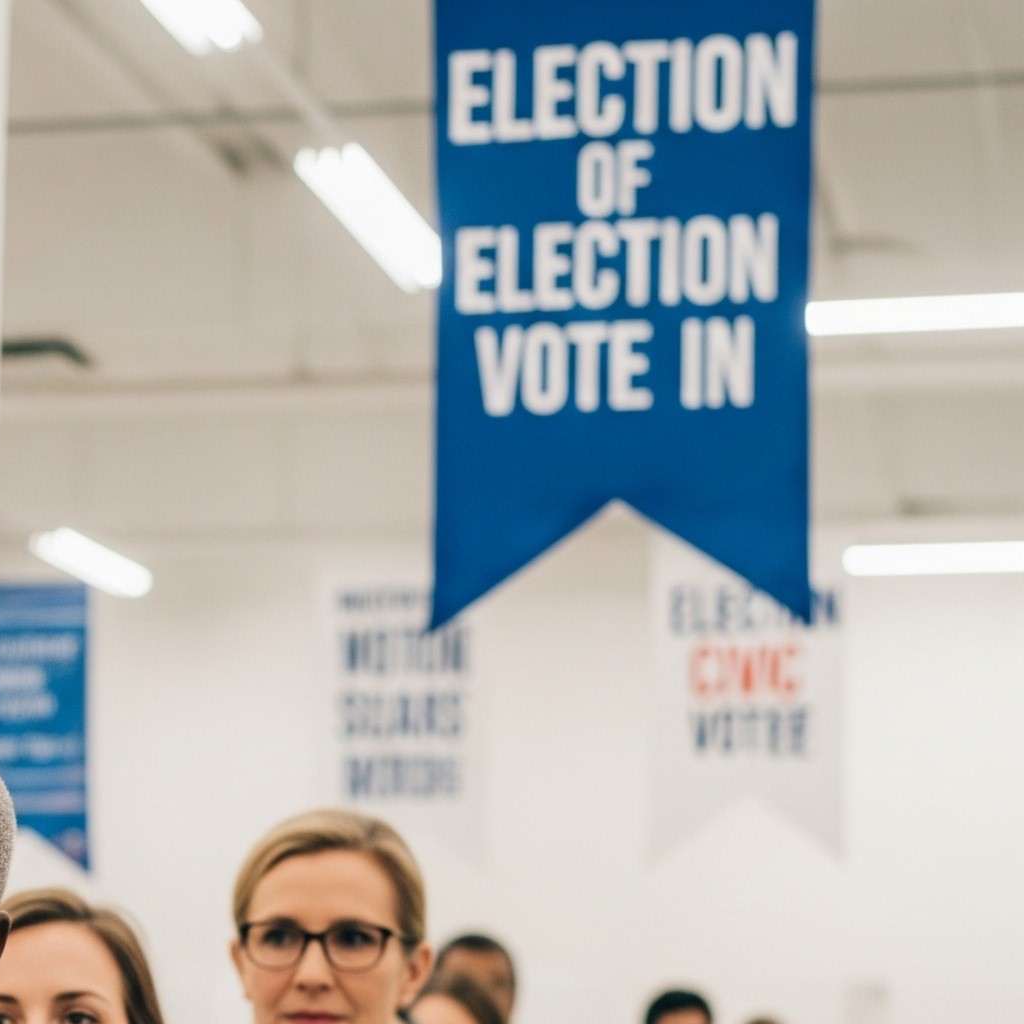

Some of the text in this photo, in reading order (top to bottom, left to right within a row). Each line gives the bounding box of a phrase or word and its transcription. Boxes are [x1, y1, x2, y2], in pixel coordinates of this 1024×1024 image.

[447, 31, 799, 145] ELECTION
[577, 140, 655, 217] OF
[454, 213, 779, 315] ELECTION
[474, 315, 756, 417] VOTE IN
